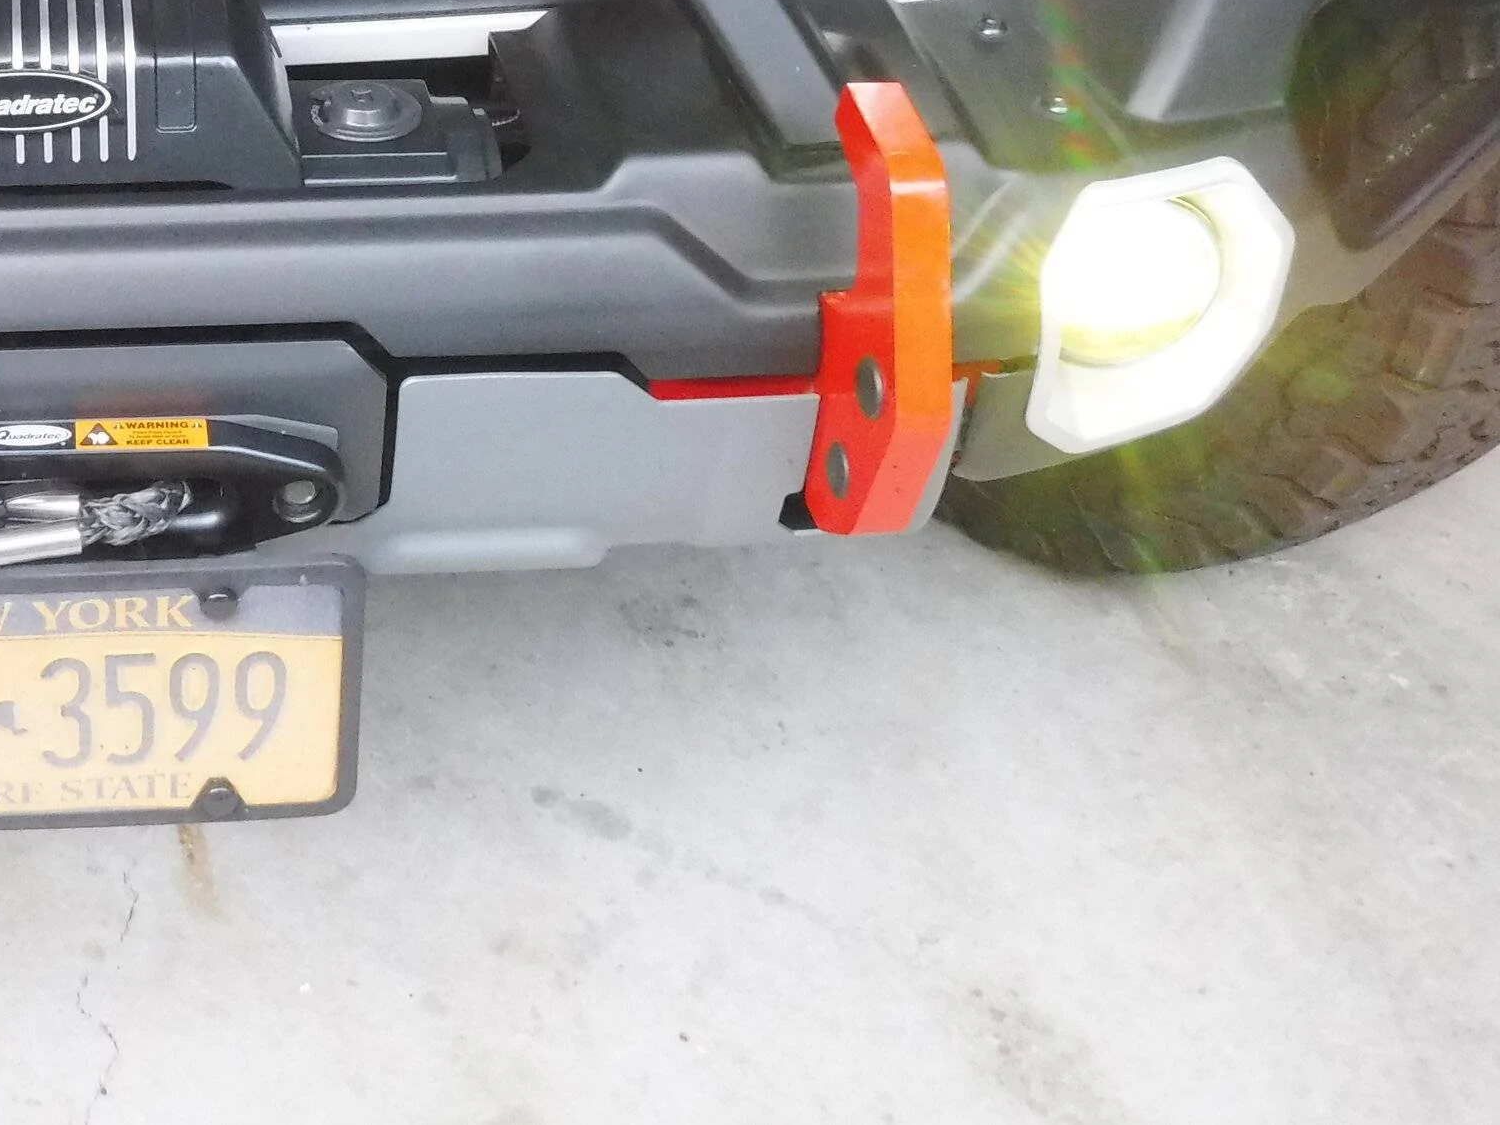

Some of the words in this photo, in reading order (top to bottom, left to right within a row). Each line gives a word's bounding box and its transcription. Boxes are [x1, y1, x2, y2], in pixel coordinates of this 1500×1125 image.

[125, 421, 189, 429] WARNING
[156, 438, 190, 446] CLEAR
[32, 594, 195, 630] YORK
[40, 651, 288, 769] 3599
[60, 771, 194, 802] STATE
